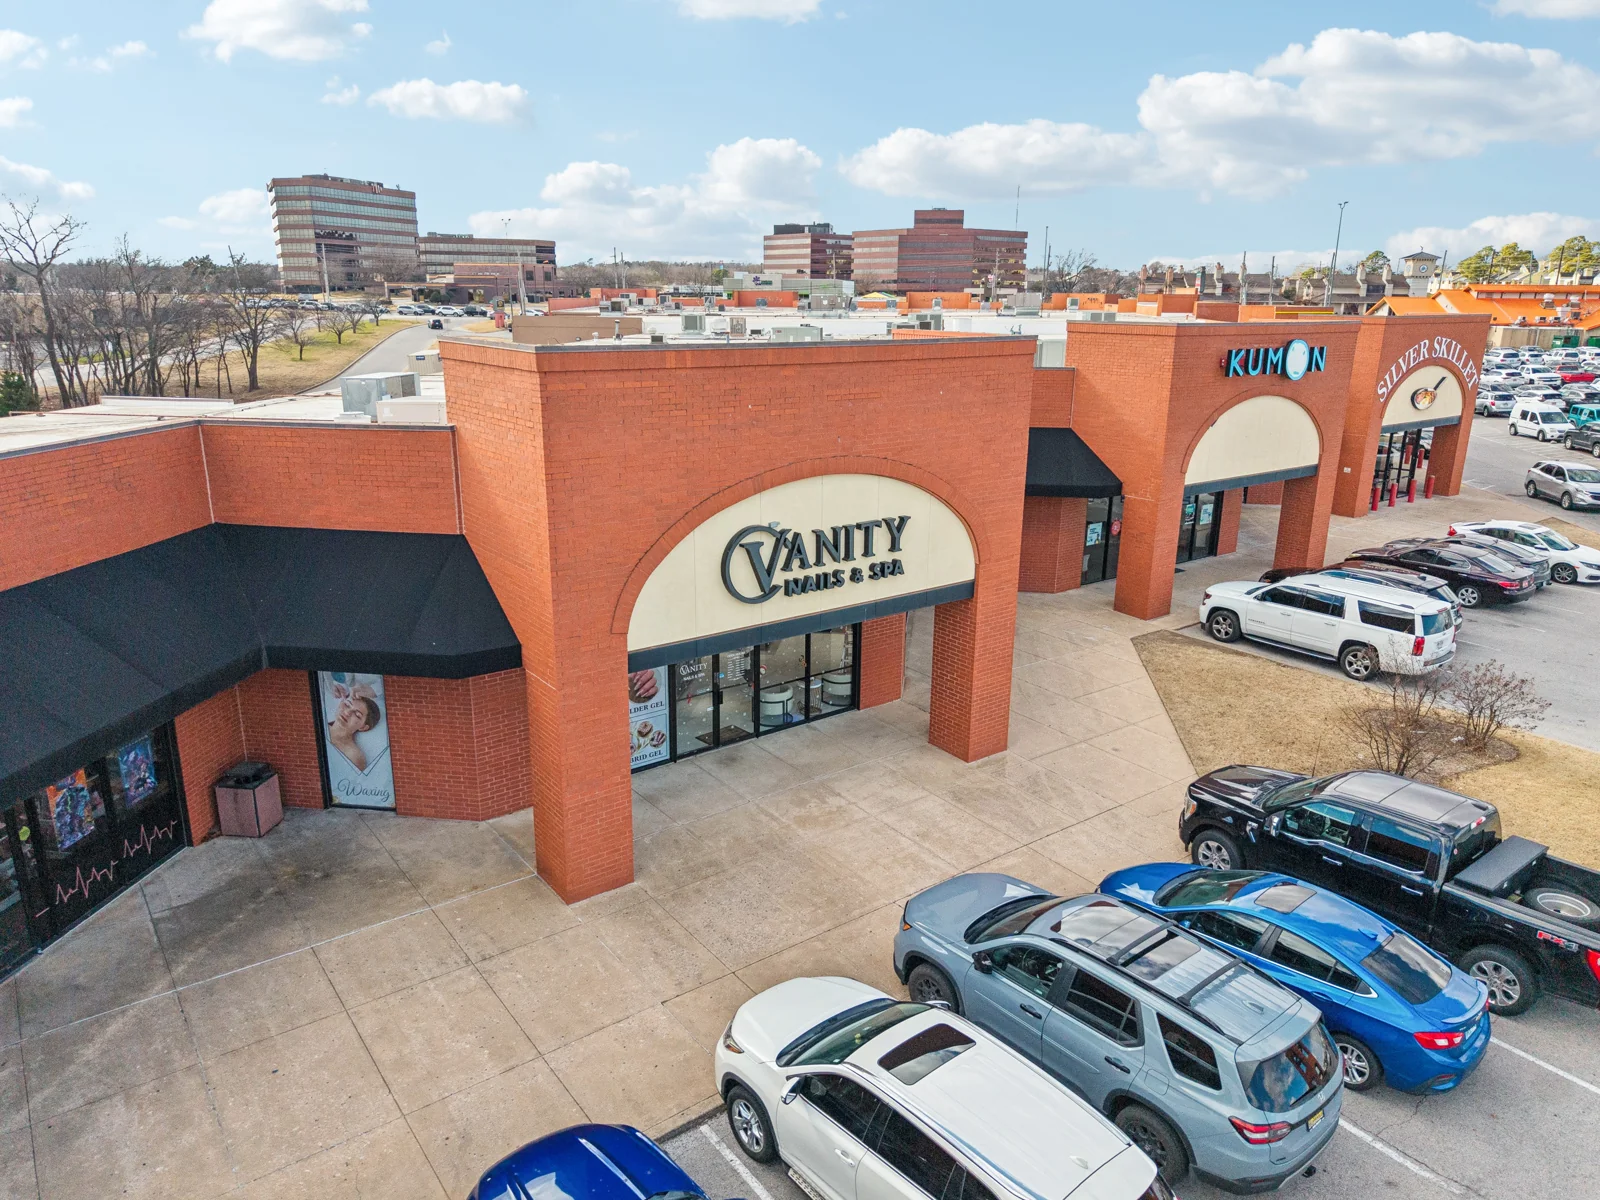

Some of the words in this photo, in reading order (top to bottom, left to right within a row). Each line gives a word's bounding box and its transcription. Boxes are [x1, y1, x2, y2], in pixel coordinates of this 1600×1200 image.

[1225, 339, 1327, 381] KUMON
[1377, 340, 1430, 403] SILVER
[1432, 336, 1479, 391] SKILLET
[736, 515, 912, 595] VANITY
[784, 568, 846, 597] NAILS
[849, 566, 865, 584] &
[868, 558, 905, 580] SPA
[650, 701, 664, 709] GEL
[649, 750, 664, 758] GEL
[337, 778, 390, 803] Waxing
